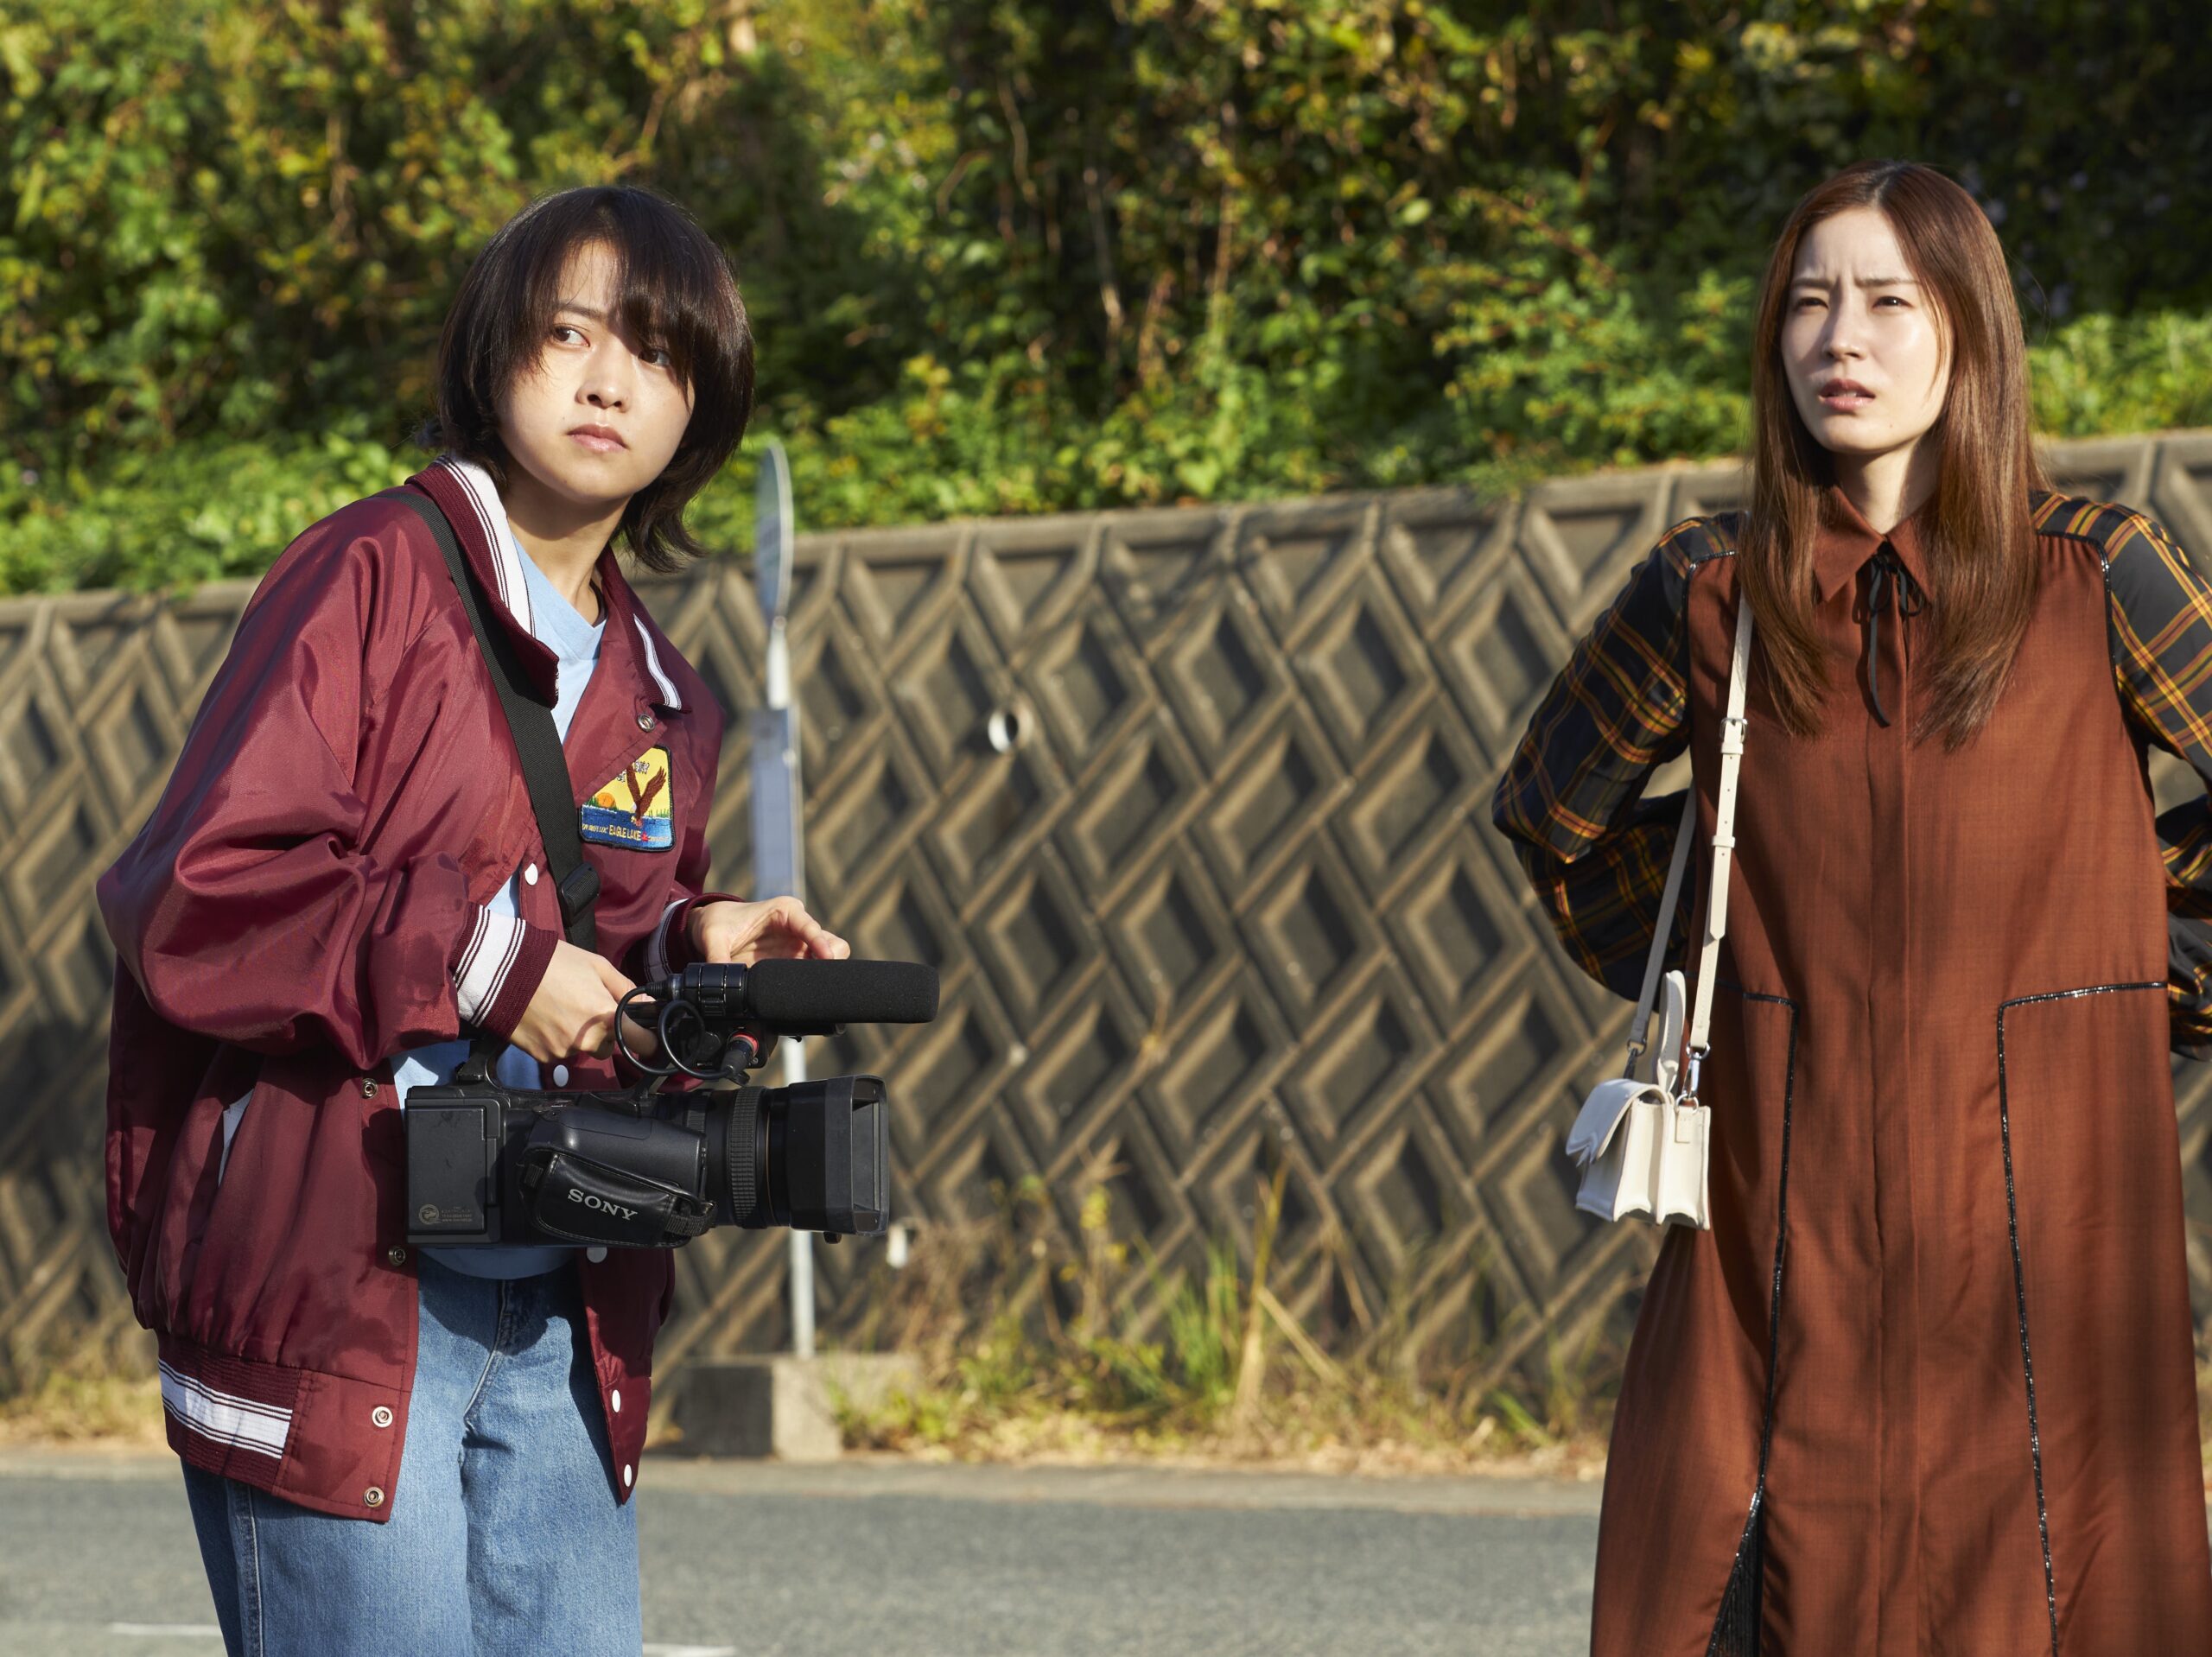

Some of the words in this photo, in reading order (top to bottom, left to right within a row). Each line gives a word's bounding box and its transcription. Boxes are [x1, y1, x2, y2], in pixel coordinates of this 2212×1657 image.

[609, 824, 626, 838] EAGLE
[627, 829, 641, 841] LAKE
[568, 1189, 638, 1220] SONY
